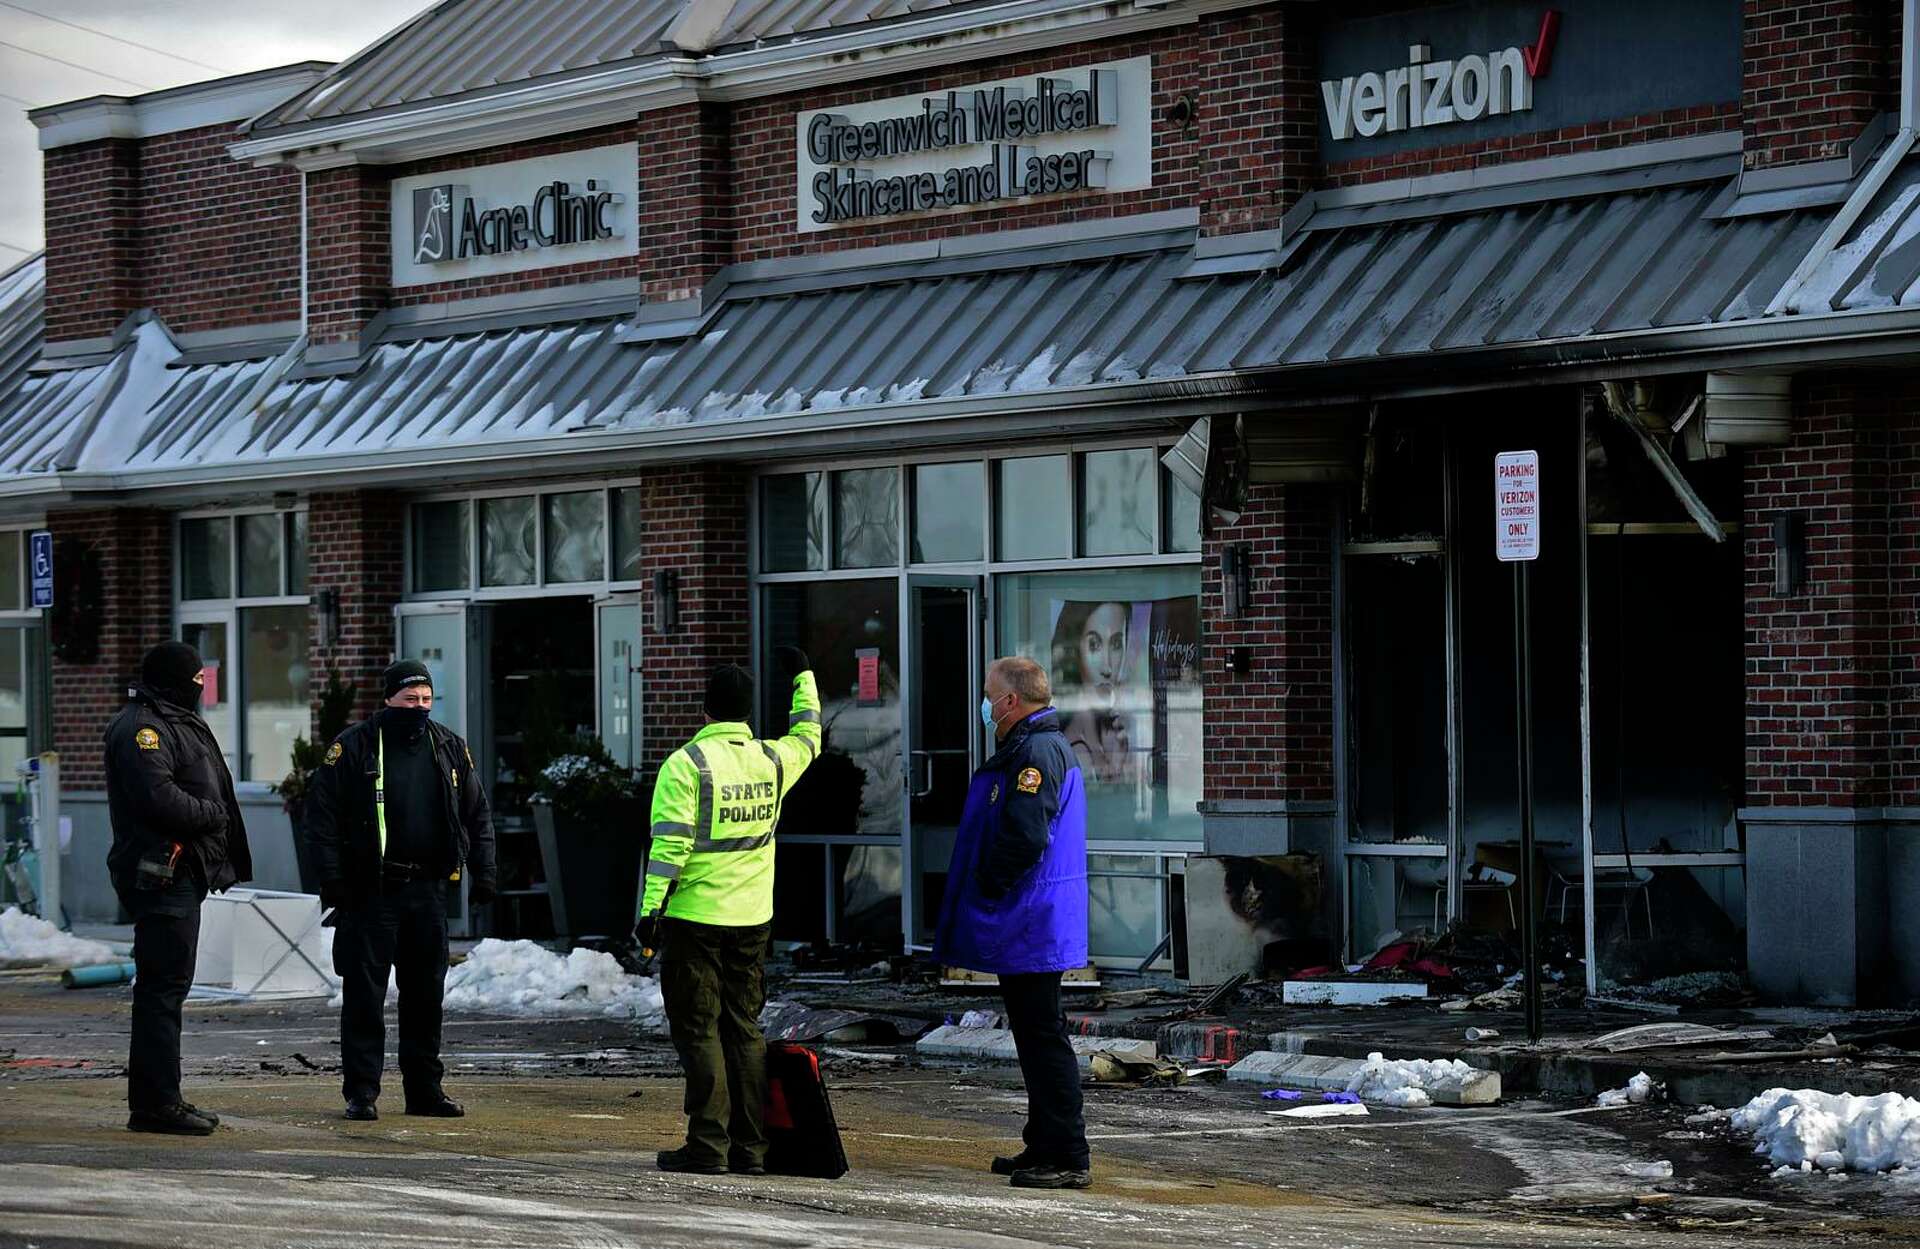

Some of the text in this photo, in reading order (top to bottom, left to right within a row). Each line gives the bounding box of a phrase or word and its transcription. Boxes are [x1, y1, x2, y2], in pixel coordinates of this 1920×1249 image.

[1321, 44, 1526, 141] verizon
[807, 69, 1099, 164] Greenwich Medical
[812, 144, 1095, 223] Skincare and Laser
[459, 179, 613, 258] Acne Clinic
[1500, 464, 1535, 478] PARKING
[1500, 491, 1535, 504] VERIZON
[1501, 506, 1535, 517] CUSTOMERS
[1508, 523, 1528, 535] ONLY
[721, 782, 773, 800] STATE
[719, 804, 773, 823] POLICE
